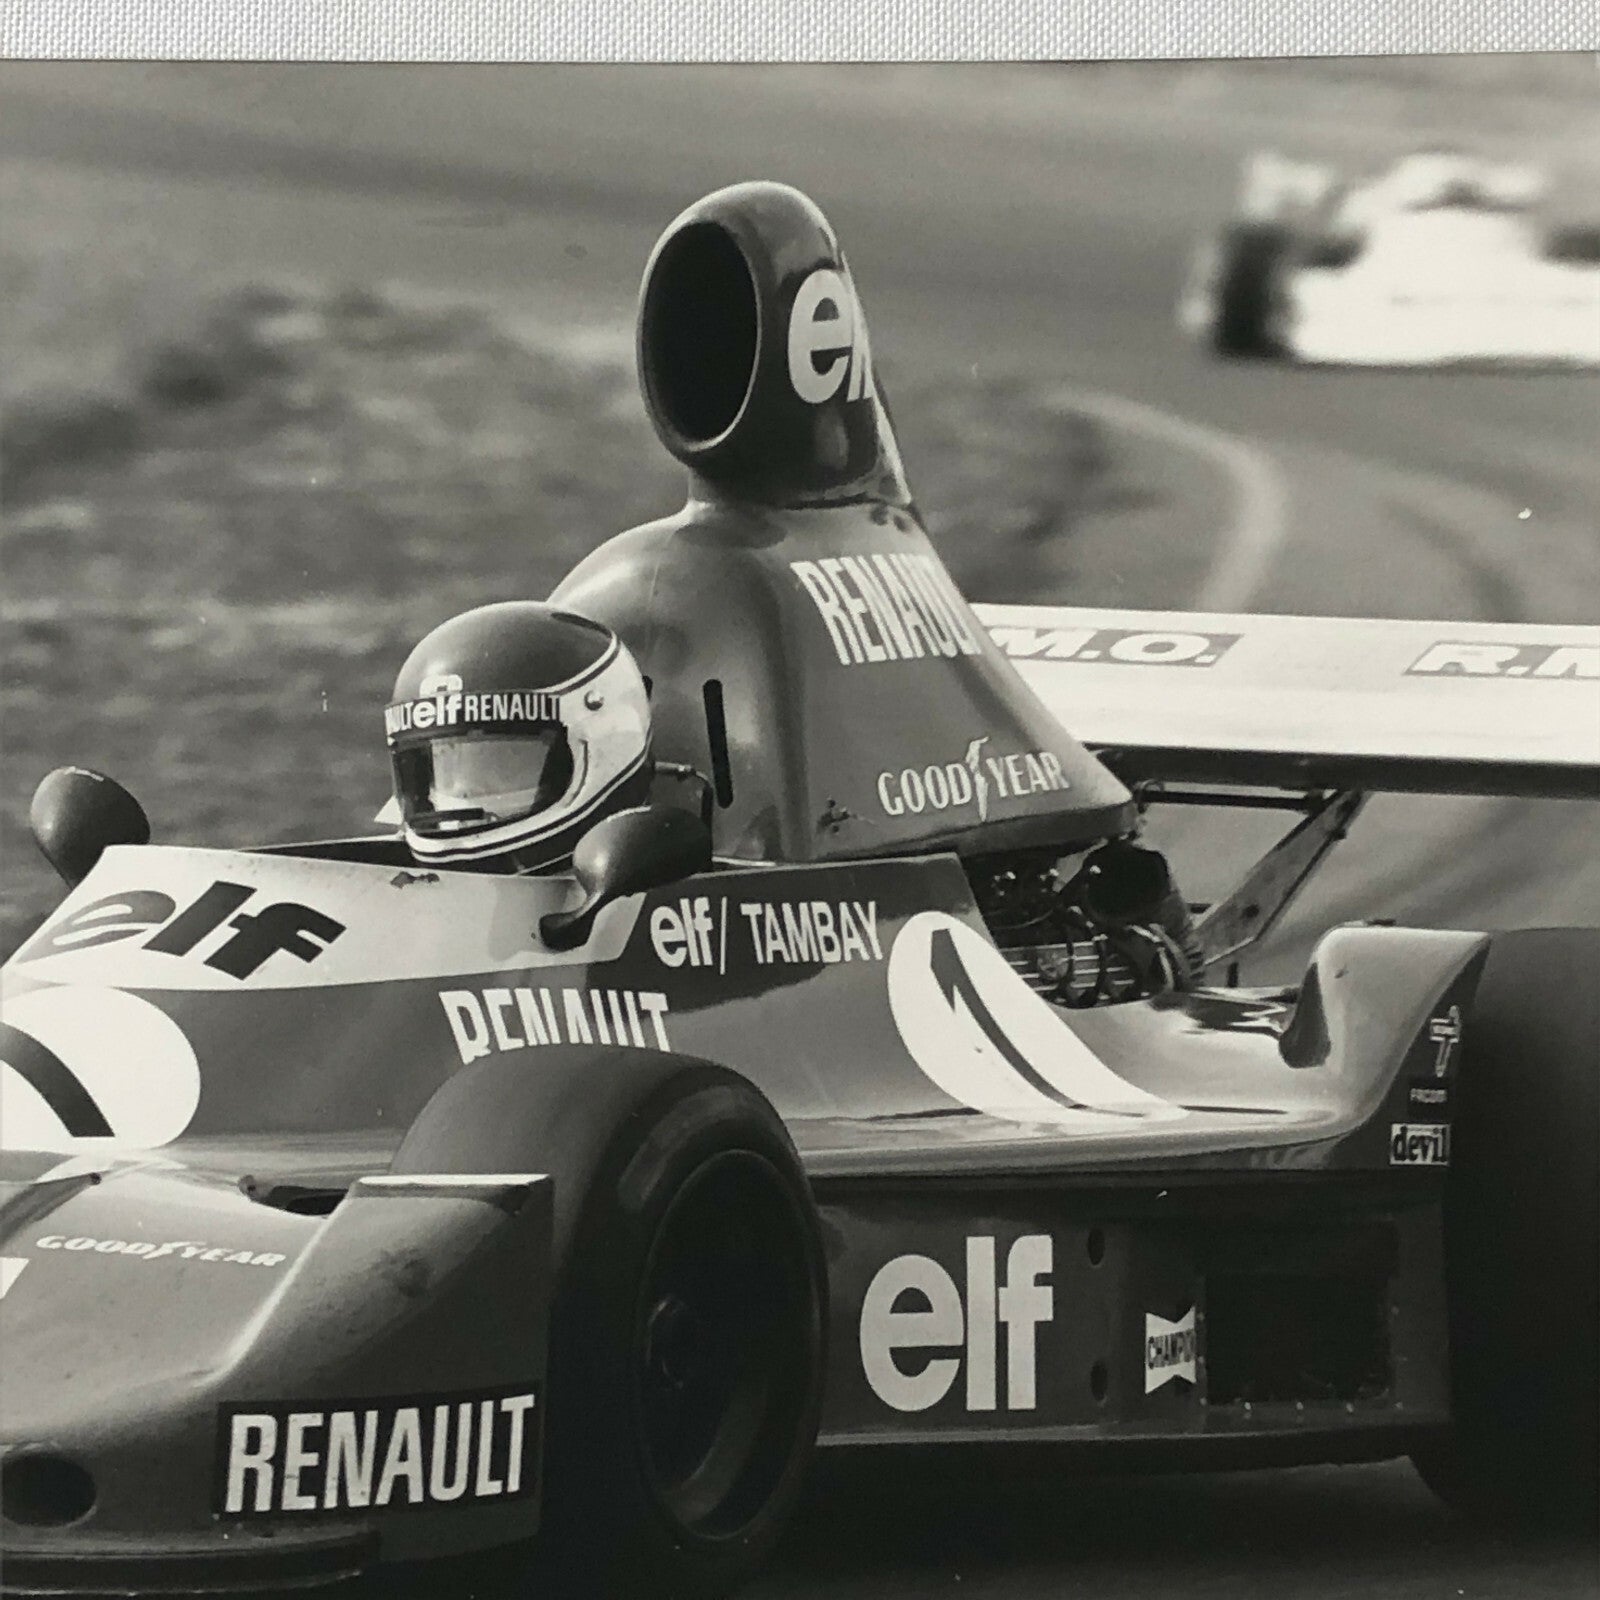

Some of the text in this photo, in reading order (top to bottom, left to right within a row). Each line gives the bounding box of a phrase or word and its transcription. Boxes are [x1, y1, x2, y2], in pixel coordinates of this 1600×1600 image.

[413, 693, 462, 728] elf
[464, 691, 563, 722] RENAULT
[15, 880, 347, 981] elf
[740, 900, 883, 964] TAMBAY
[1393, 1124, 1448, 1162] devil
[860, 1234, 1053, 1411] elf
[225, 1394, 535, 1512] RENAULT
